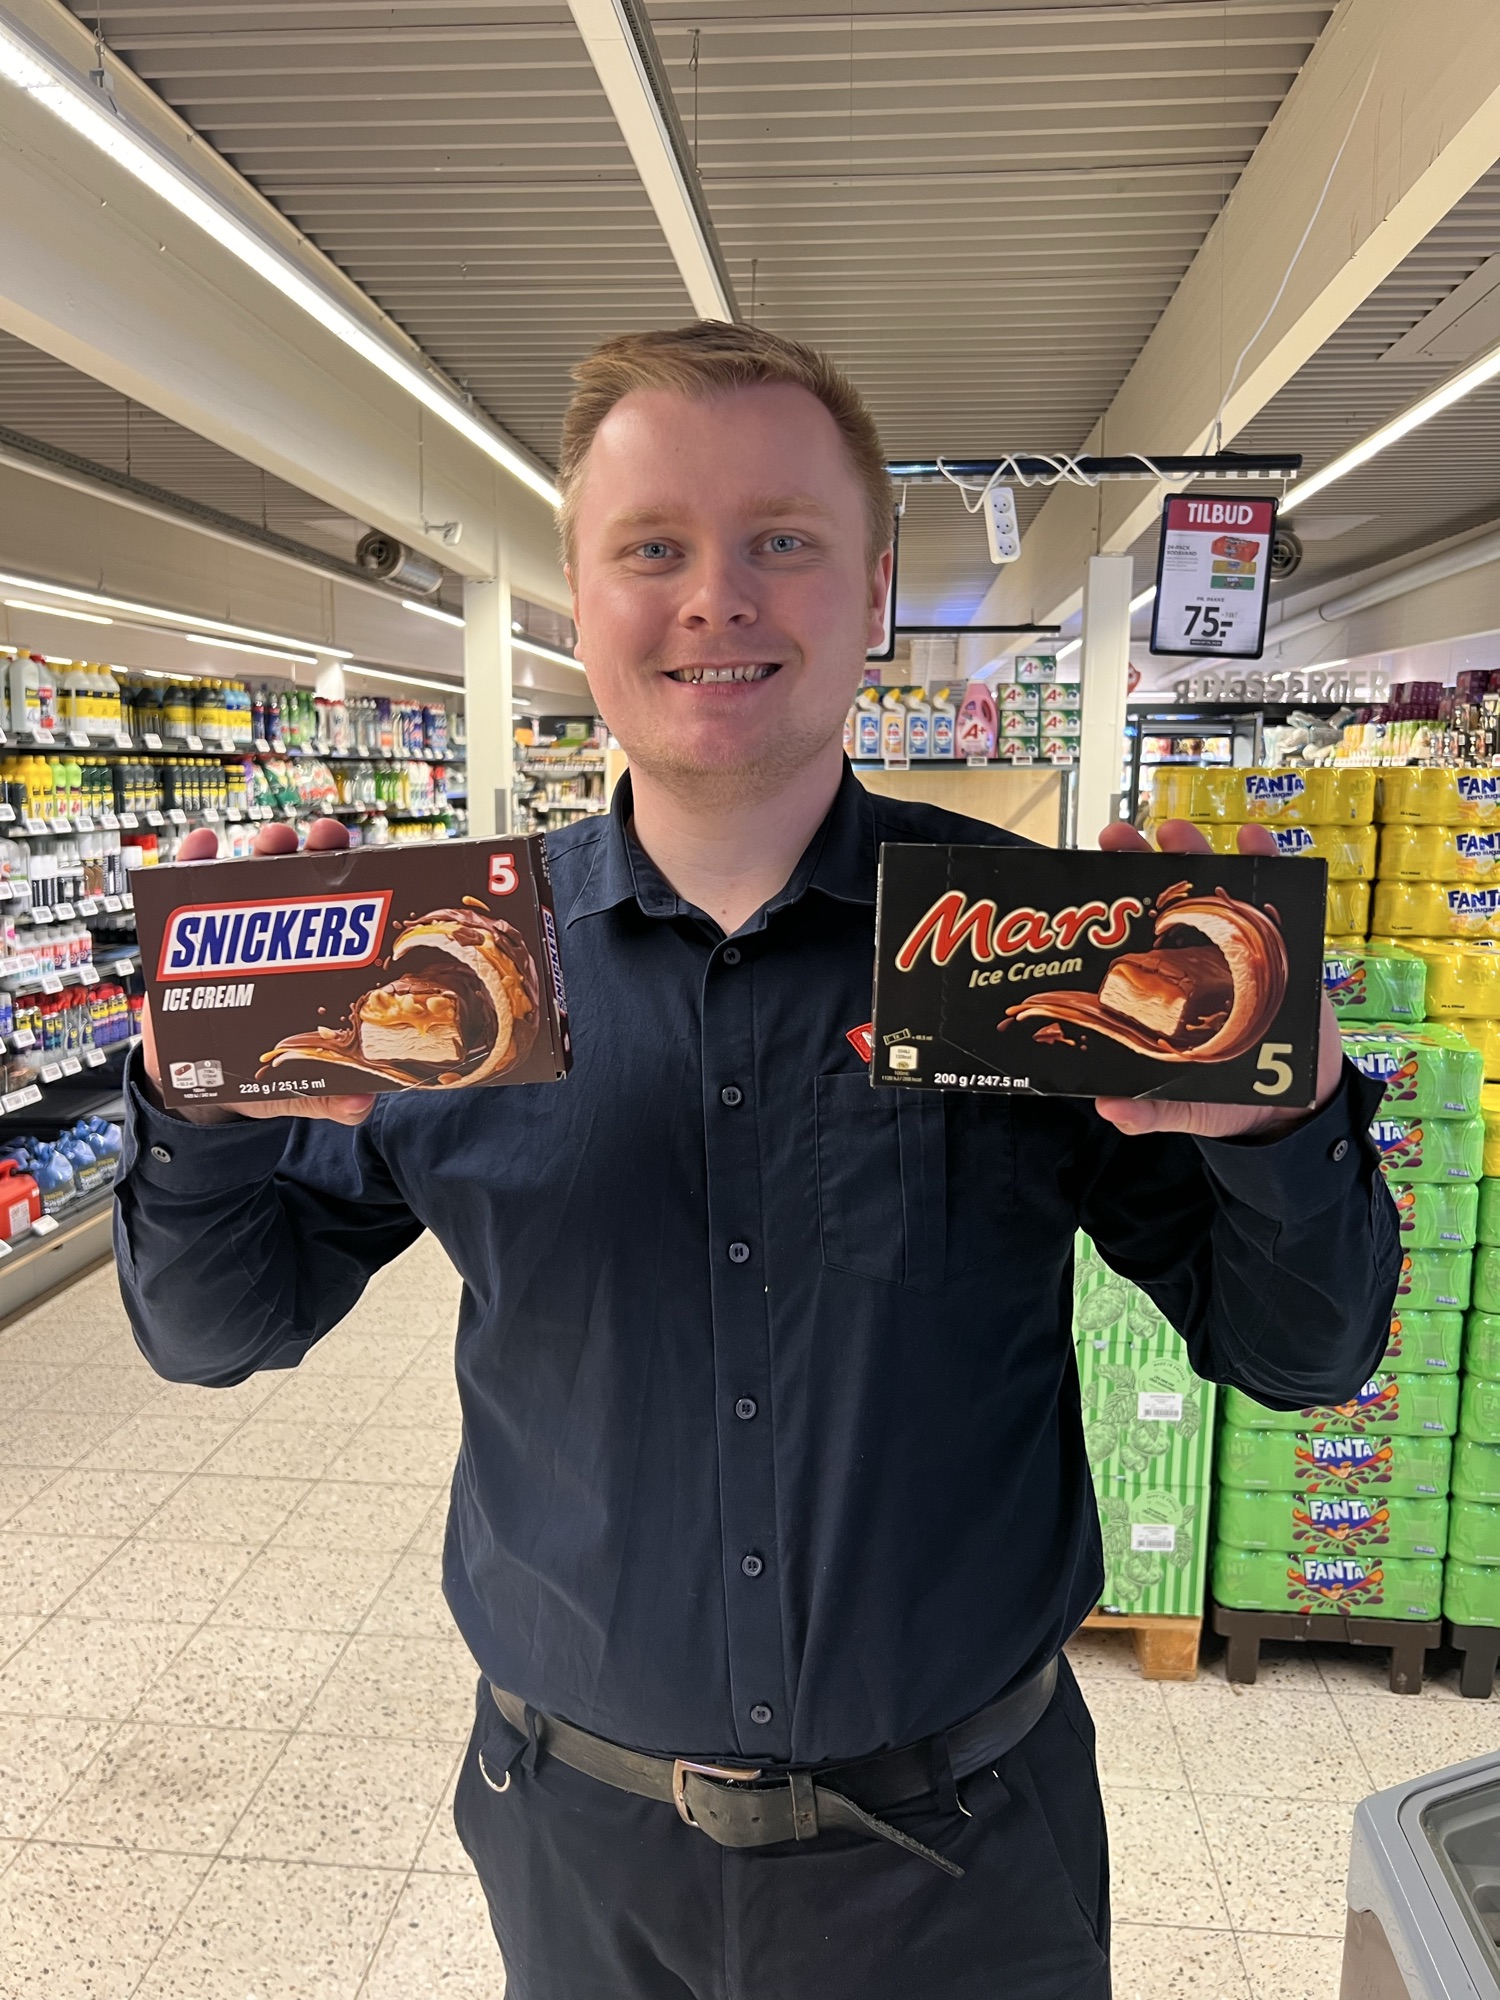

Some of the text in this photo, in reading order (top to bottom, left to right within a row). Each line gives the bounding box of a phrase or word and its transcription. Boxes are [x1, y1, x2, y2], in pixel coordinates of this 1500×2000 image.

[1188, 503, 1253, 525] TILBUD
[1023, 662, 1039, 675] A+
[1005, 689, 1022, 701] A+
[1044, 689, 1063, 701] A+
[1195, 671, 1390, 702] DESSERTER
[963, 724, 986, 740] A+
[1005, 717, 1022, 729] A+
[1044, 716, 1063, 729] A+
[1246, 774, 1304, 793] FANTA
[1457, 776, 1500, 795] FAN
[1270, 829, 1313, 848] NTA
[488, 853, 519, 895] 5
[1448, 890, 1500, 910] FANT
[170, 904, 377, 968] SNICKERS
[895, 890, 1142, 972] Mars
[544, 911, 566, 1014] SNICKERS
[968, 958, 1082, 988] Ice Cream
[162, 983, 255, 1011] ICE CREAM
[1252, 1043, 1294, 1096] 5
[239, 1079, 325, 1095] 228 g / 251.5 ml
[934, 1073, 1029, 1088] 200 g / 247.5 ml
[1312, 1437, 1373, 1459] FANTA
[1309, 1500, 1370, 1522] FANTA
[1304, 1560, 1365, 1581] FANTA
